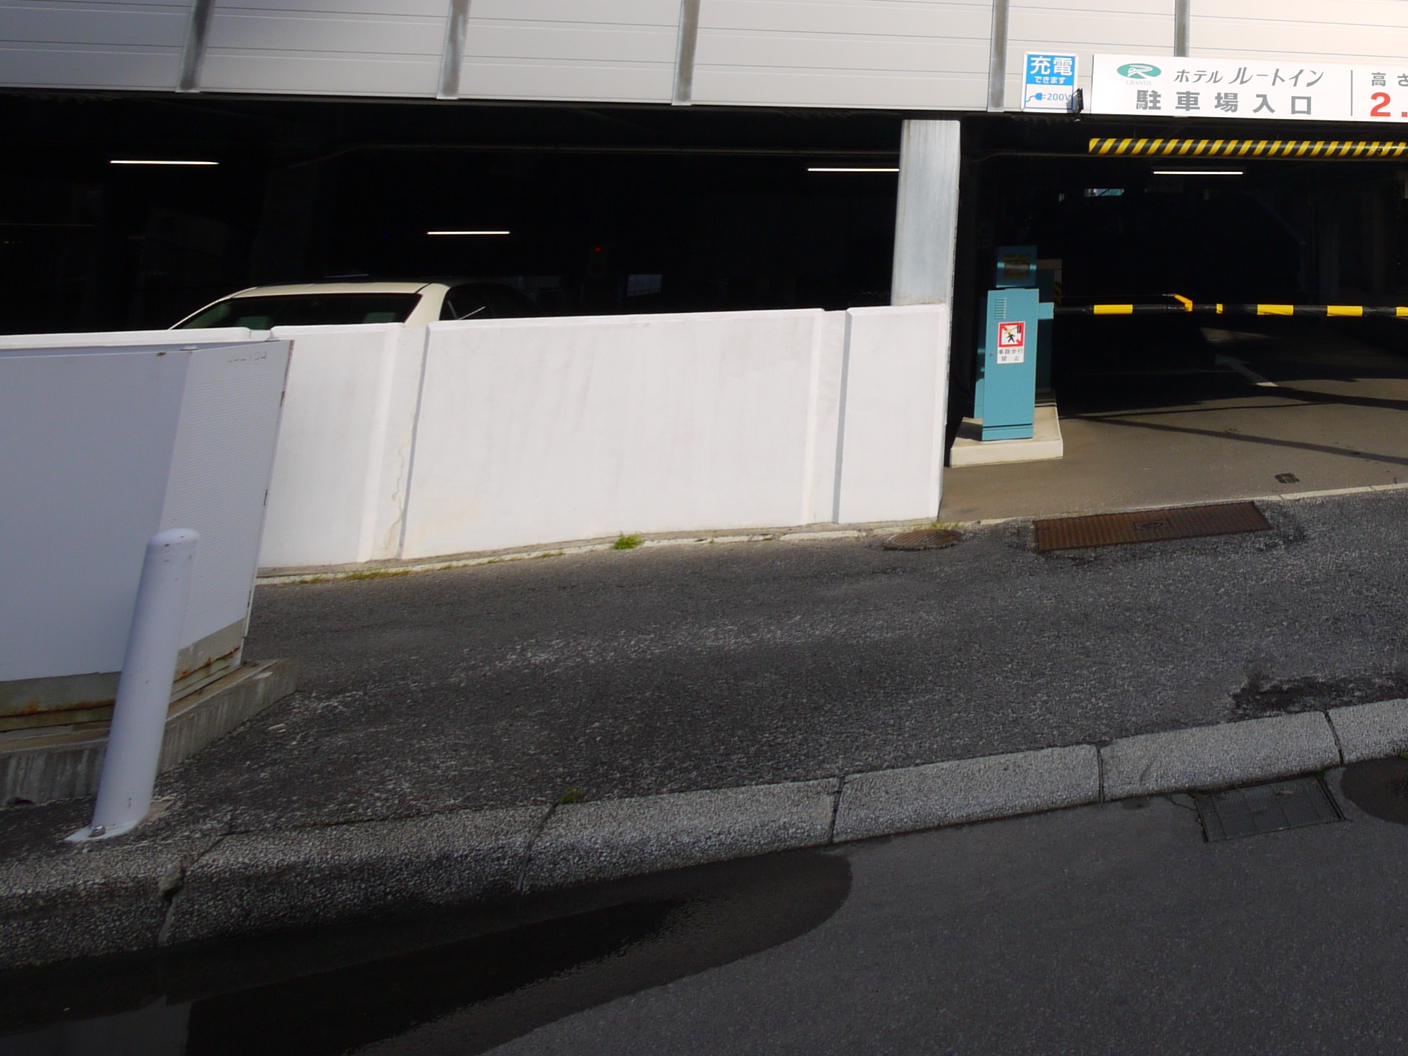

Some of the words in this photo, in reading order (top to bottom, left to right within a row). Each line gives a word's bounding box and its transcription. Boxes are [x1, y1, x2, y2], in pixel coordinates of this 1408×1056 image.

[1030, 56, 1073, 76] 充電
[1034, 75, 1067, 85] できます
[1046, 92, 1071, 102] 200V
[1136, 90, 1312, 115] 駐車場入口
